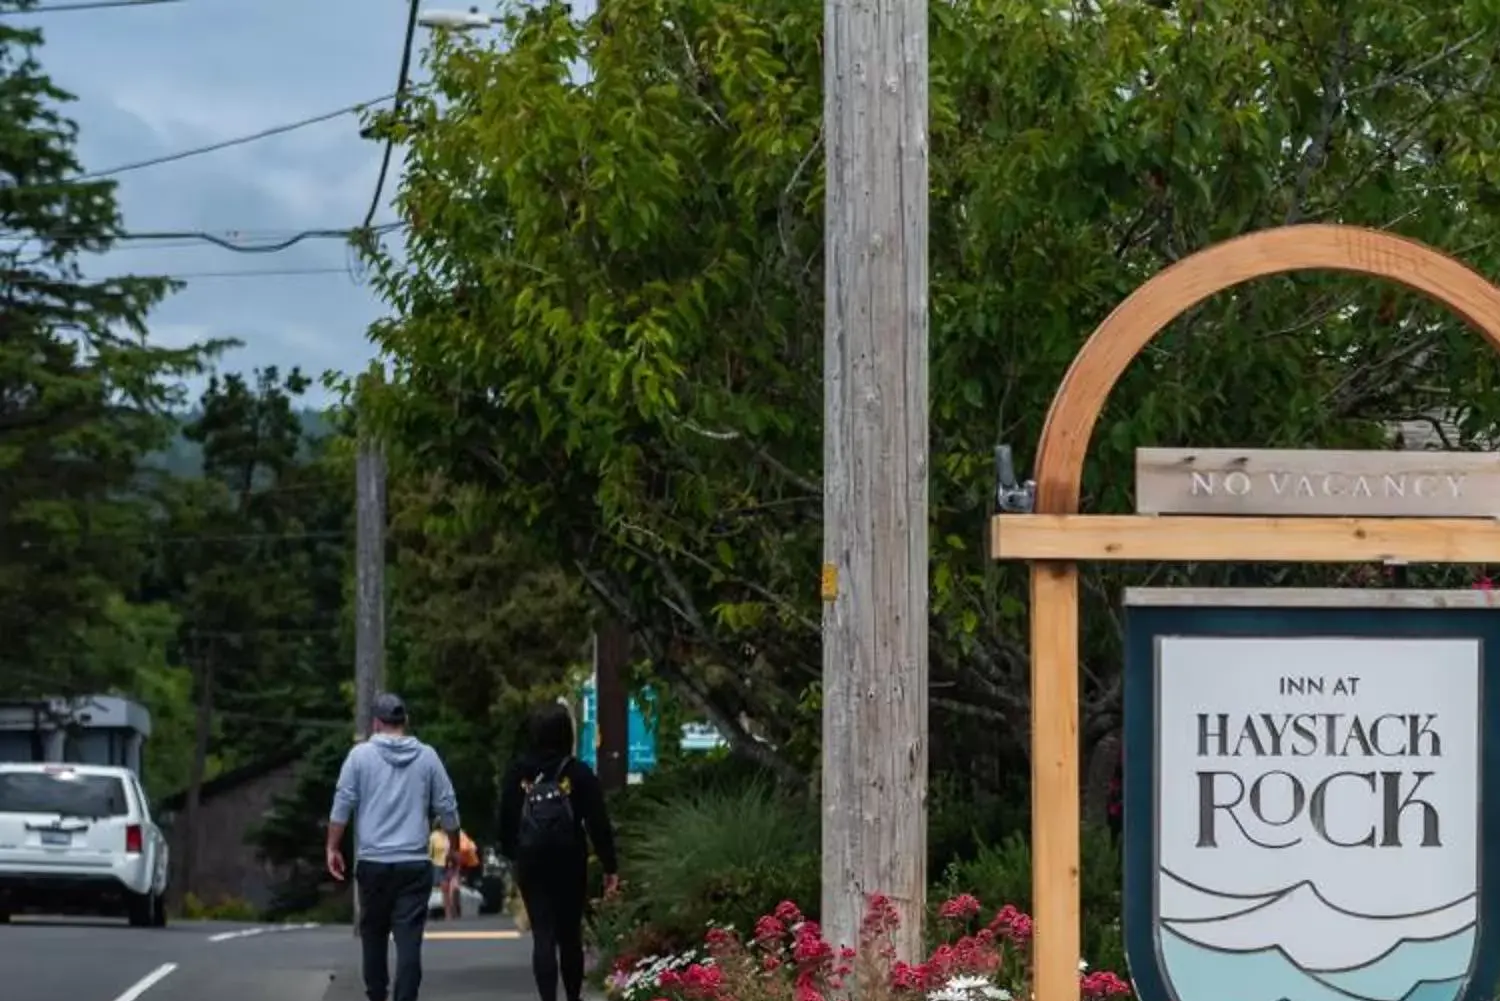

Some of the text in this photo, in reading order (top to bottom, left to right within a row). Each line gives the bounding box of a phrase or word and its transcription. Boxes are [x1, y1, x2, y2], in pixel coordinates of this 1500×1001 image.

[1190, 471, 1468, 498] NO VACANCY
[1279, 676, 1360, 695] INN AT
[1196, 713, 1441, 757] HAYSTACK
[1194, 770, 1443, 849] ROCK
